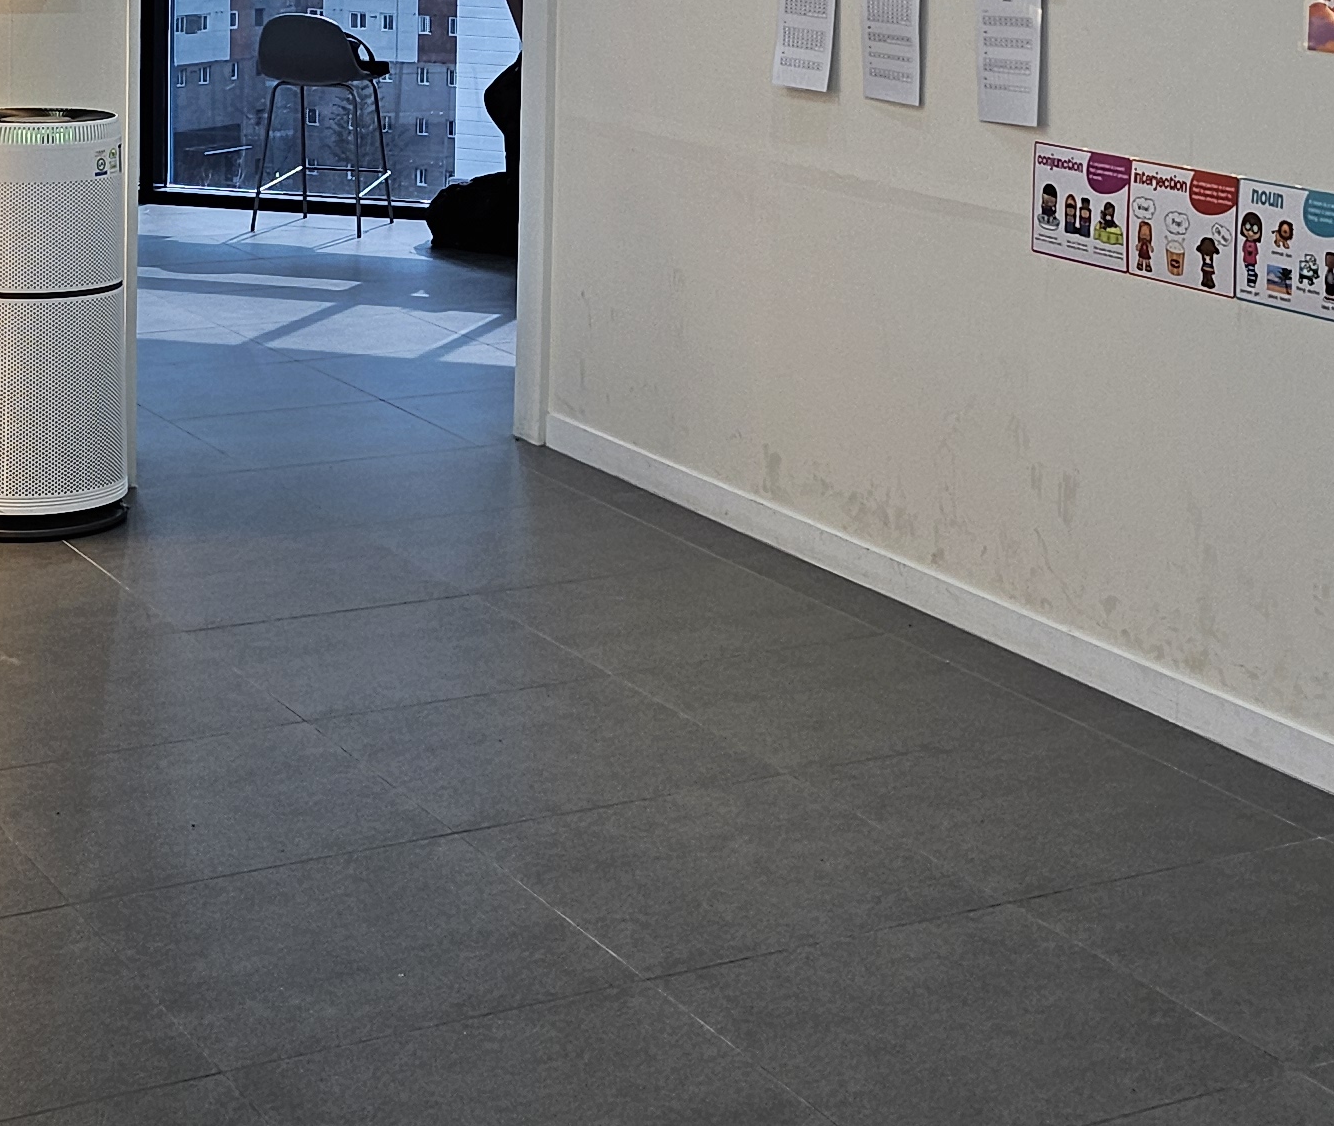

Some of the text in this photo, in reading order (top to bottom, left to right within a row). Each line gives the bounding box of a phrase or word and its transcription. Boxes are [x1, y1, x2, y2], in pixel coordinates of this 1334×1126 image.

[1037, 153, 1083, 173] conjunction
[1134, 168, 1187, 193] interjection
[1251, 188, 1284, 209] noun
